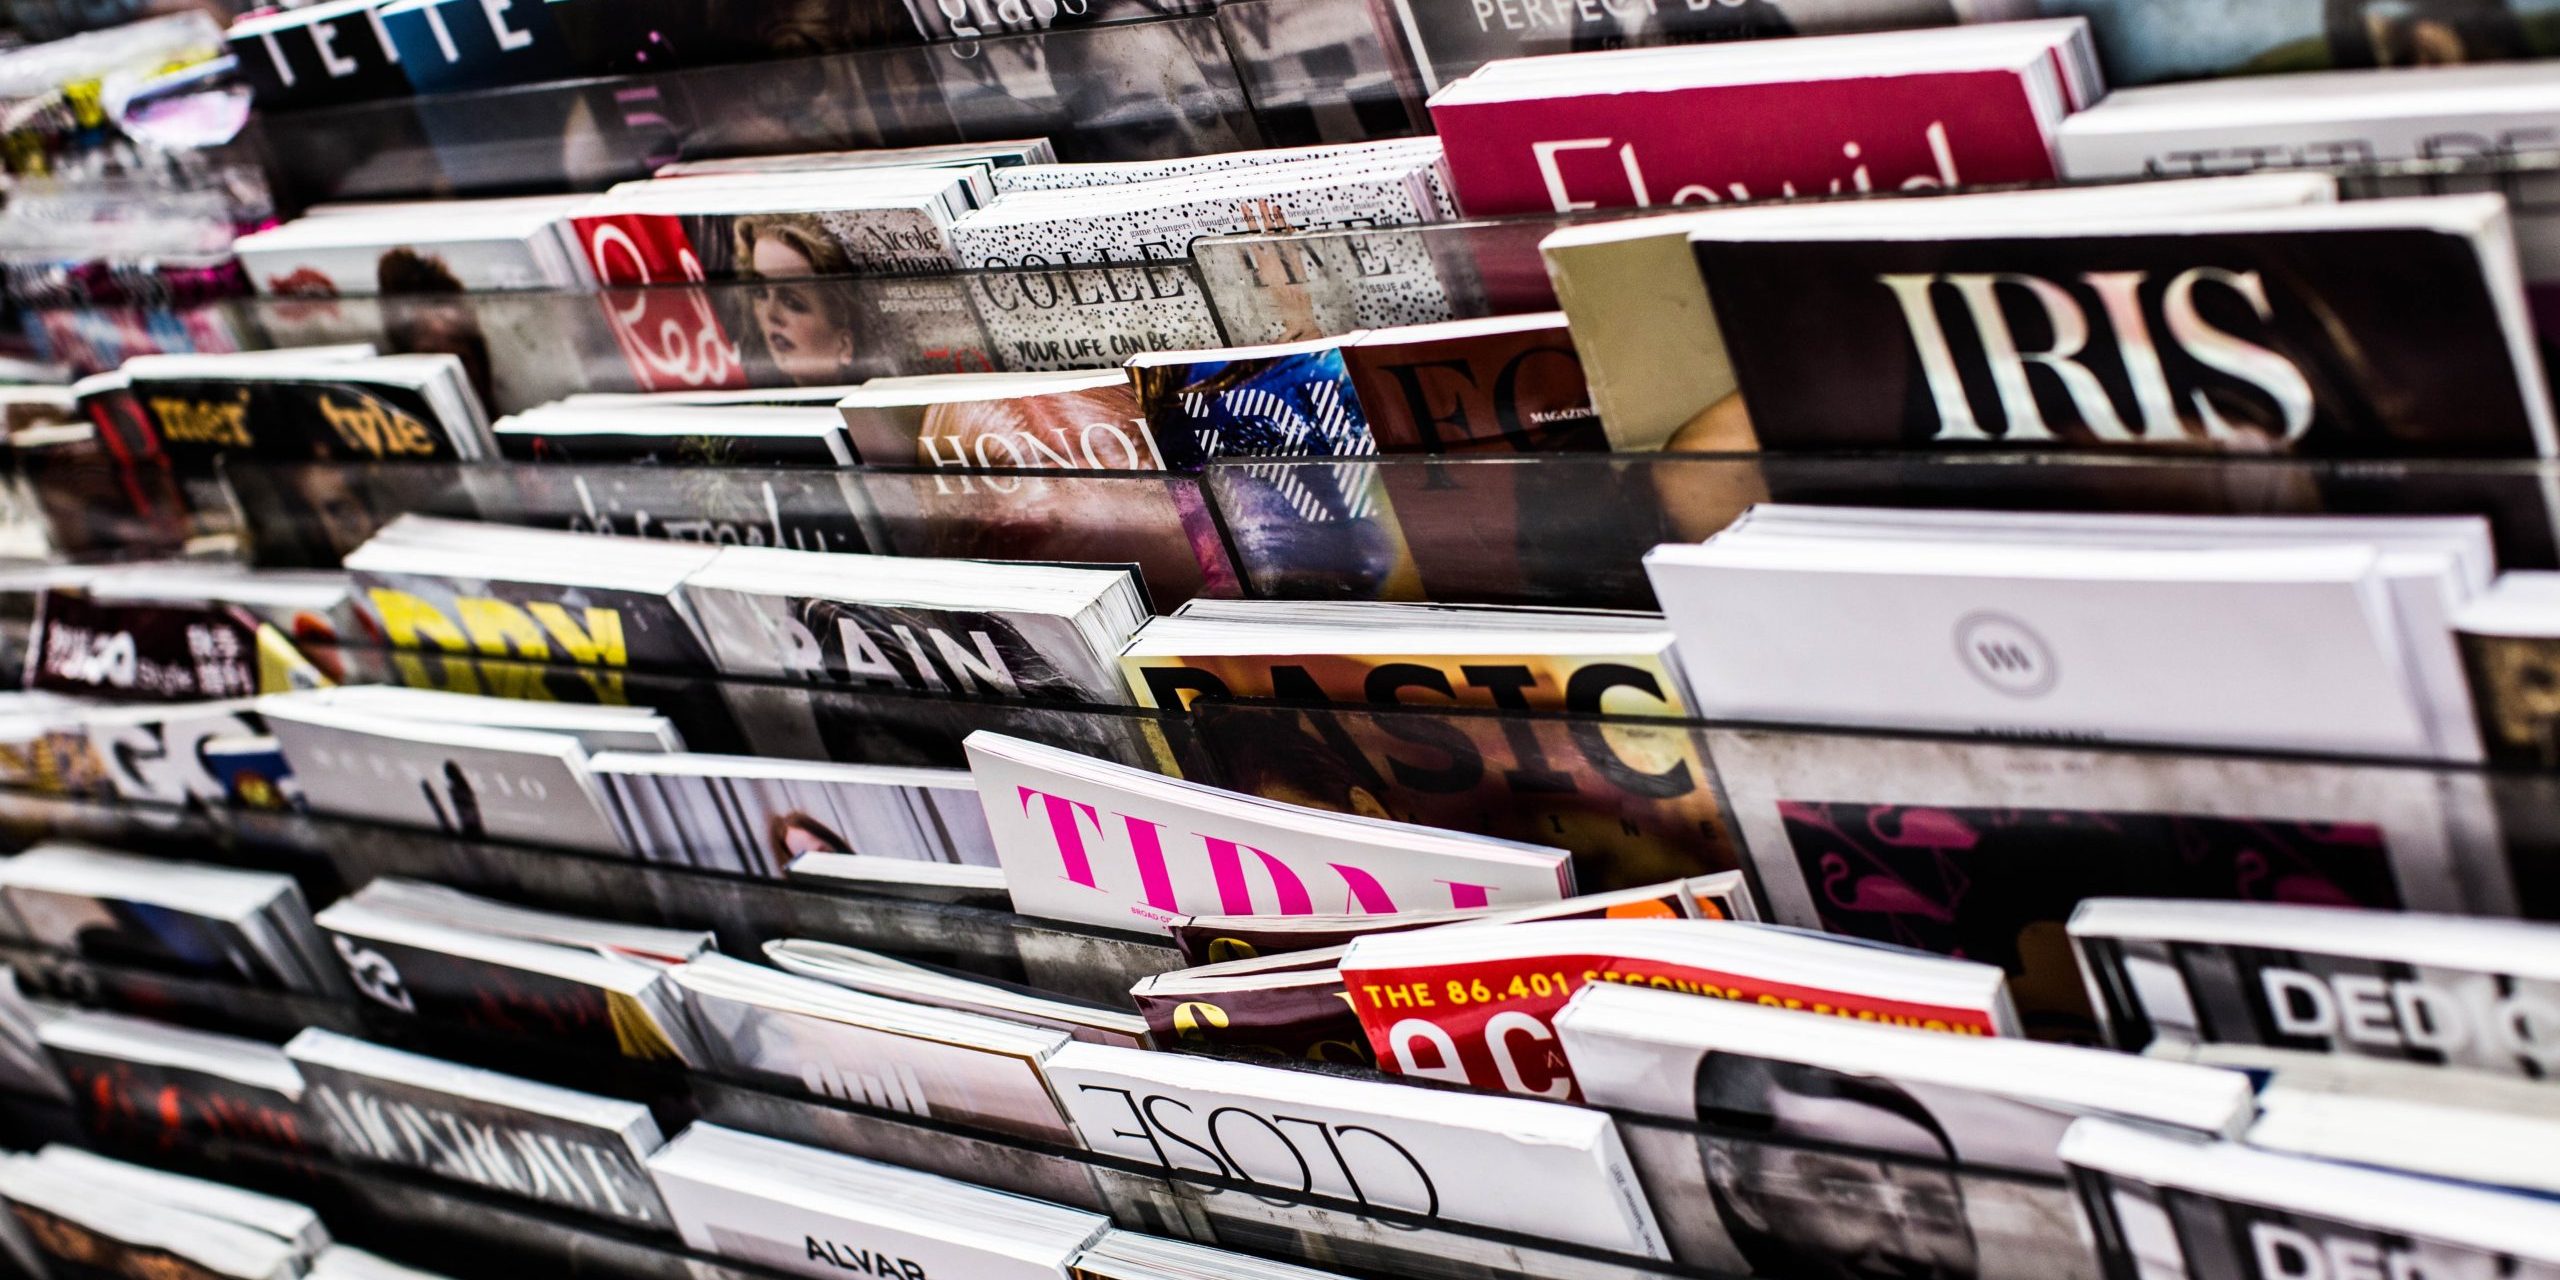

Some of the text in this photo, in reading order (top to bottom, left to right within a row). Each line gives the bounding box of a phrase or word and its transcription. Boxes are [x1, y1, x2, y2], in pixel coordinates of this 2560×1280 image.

[1531, 121, 1960, 212] Flid
[865, 224, 942, 253] Nicole
[1129, 227, 1152, 239] game
[1153, 219, 1192, 235] changers
[1197, 214, 1231, 229] thought
[1288, 206, 1325, 220] breakers
[1332, 202, 1352, 214] style
[1353, 199, 1385, 211] makers
[593, 223, 742, 390] Red
[1366, 280, 1412, 294] ISSUE 48
[1013, 340, 1066, 363] YOUR
[1064, 337, 1103, 360] LIFE
[1110, 332, 1146, 355] CAN
[1147, 331, 1175, 351] BE
[1876, 266, 2318, 443] IRIS
[1528, 406, 1594, 425] MAGAZIN
[919, 417, 1168, 496] HONO
[1016, 784, 1502, 918] TIDA
[1131, 906, 1159, 921] BROAD
[1362, 982, 1436, 1009] THE
[1445, 970, 1571, 1006] 86.401
